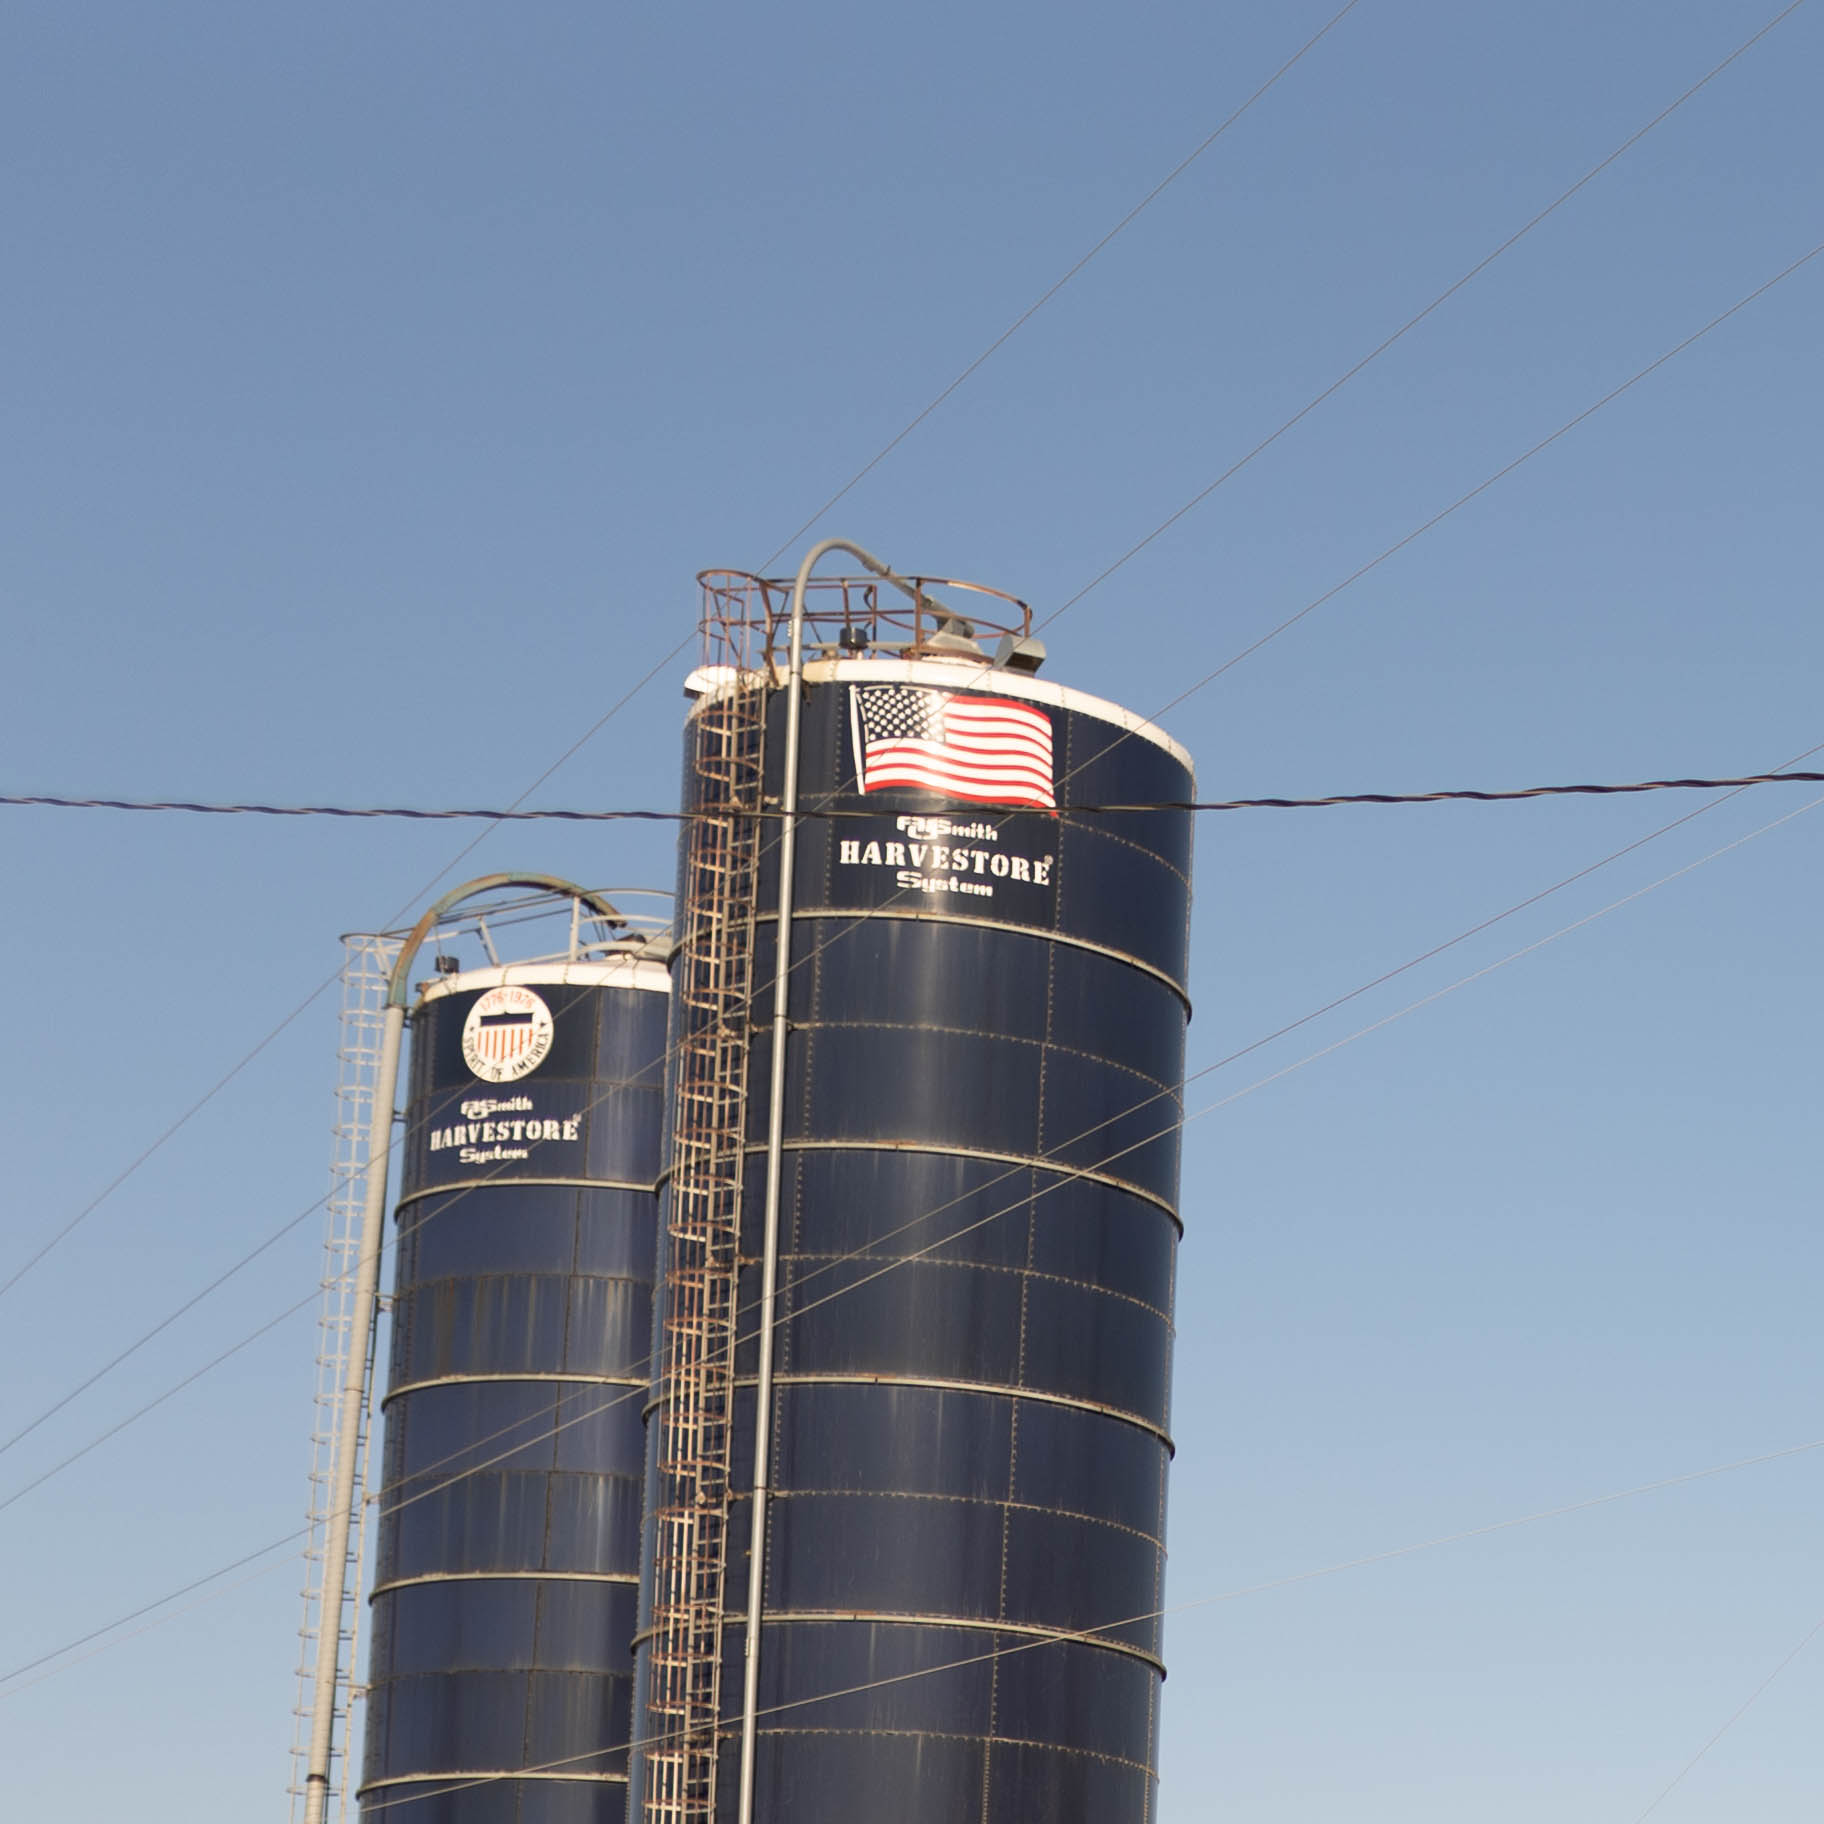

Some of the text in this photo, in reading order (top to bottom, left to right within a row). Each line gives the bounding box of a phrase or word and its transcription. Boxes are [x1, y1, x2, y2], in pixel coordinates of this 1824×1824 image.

[896, 870, 993, 897] System
[464, 1032, 549, 1080] SPIRIT OF AMERICA
[459, 1144, 529, 1164] System
